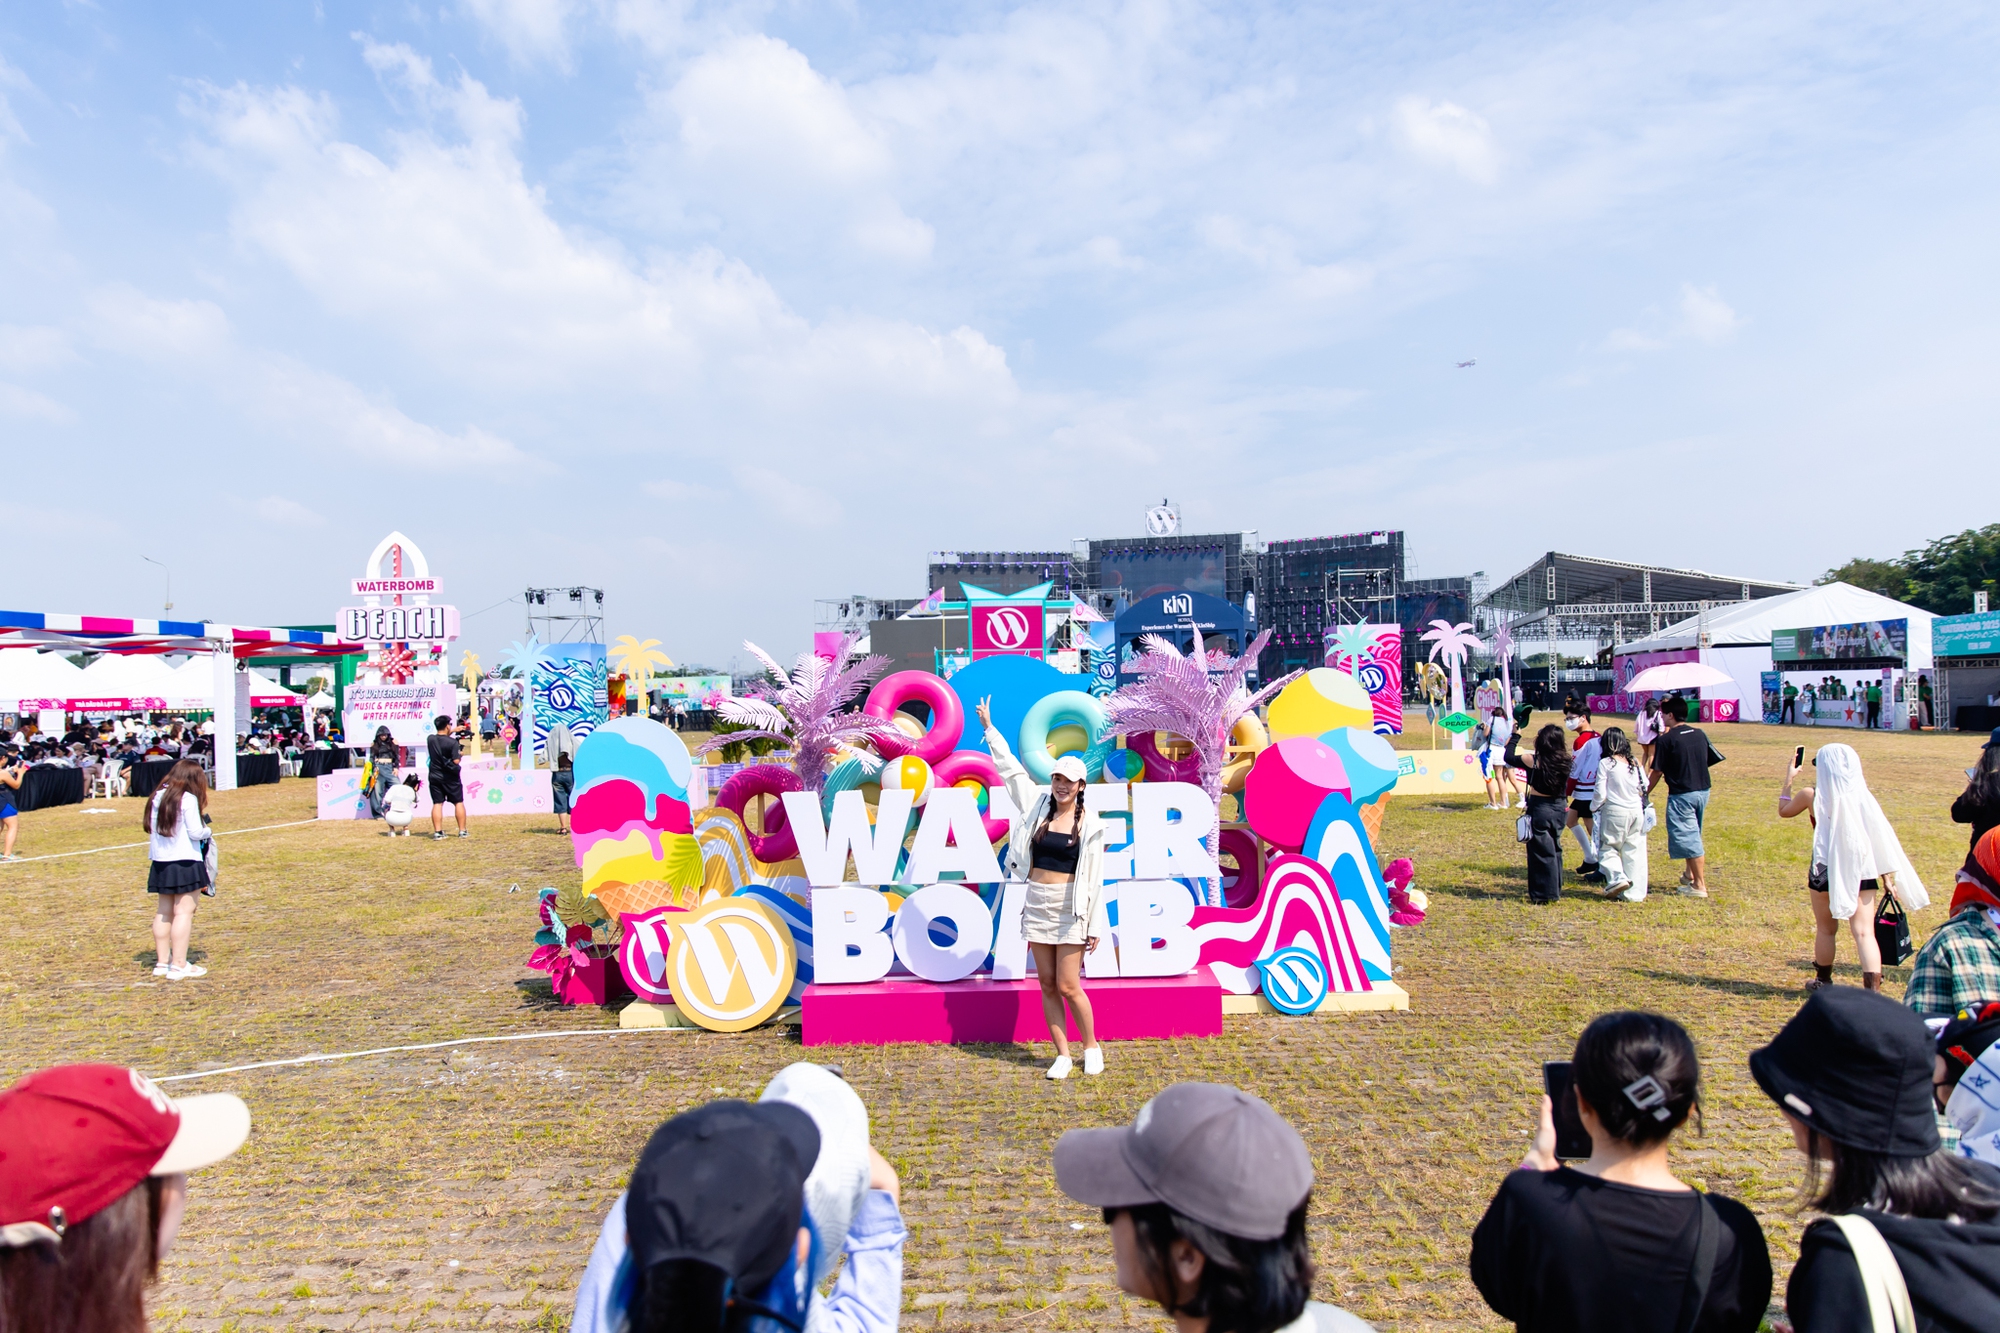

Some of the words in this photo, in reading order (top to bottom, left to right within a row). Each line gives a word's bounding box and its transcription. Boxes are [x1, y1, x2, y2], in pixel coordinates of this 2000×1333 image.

[356, 580, 435, 592] WATERBOMB
[345, 607, 445, 641] BEACH
[365, 688, 414, 699] WATERBOMB
[354, 702, 376, 710] MUSIC
[377, 702, 382, 710] &
[384, 701, 431, 710] PERFOMANCE
[363, 712, 388, 720] WATER
[389, 711, 423, 720] FIGHTING
[1814, 708, 1842, 720] eineken
